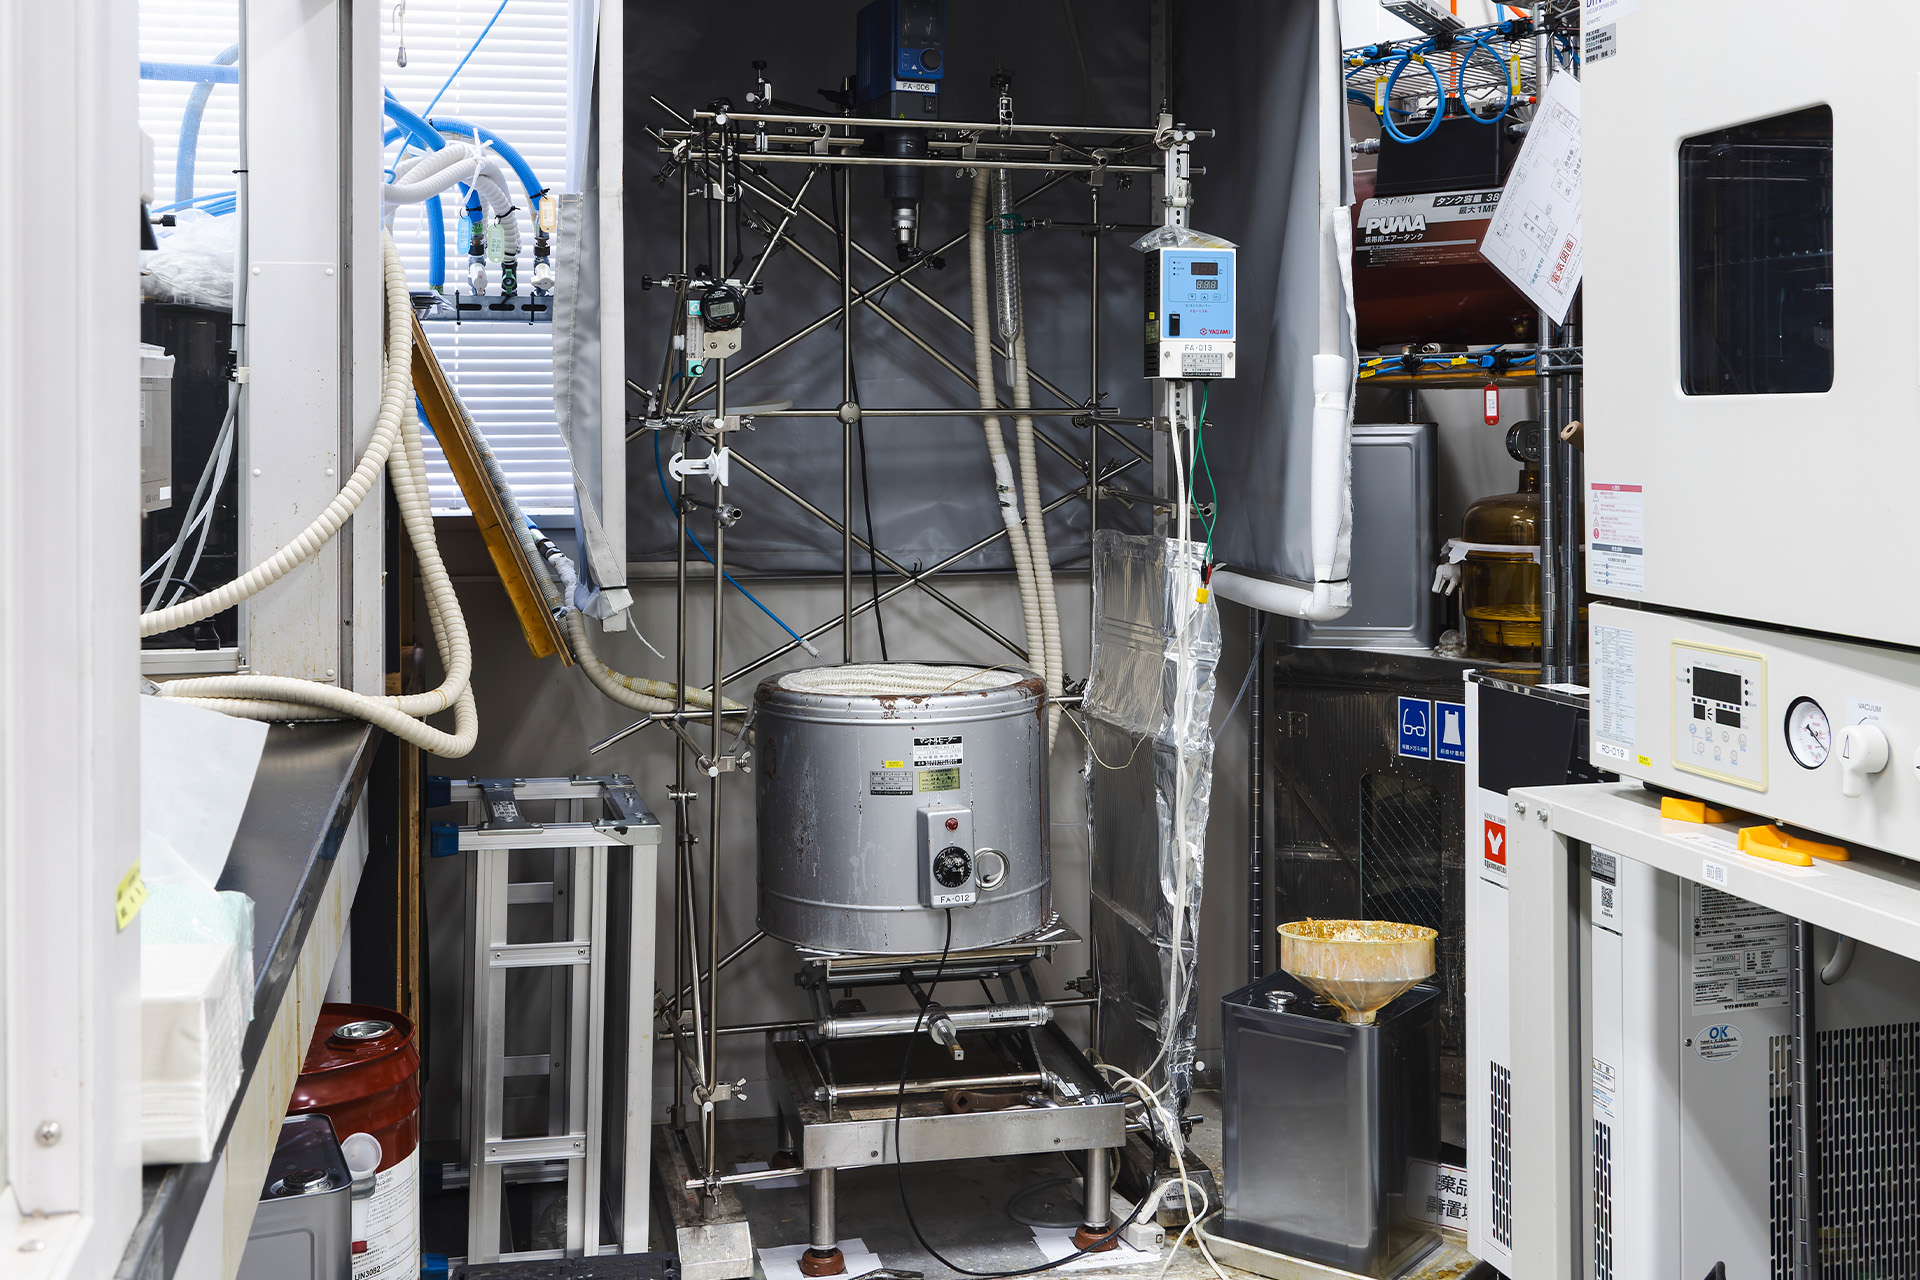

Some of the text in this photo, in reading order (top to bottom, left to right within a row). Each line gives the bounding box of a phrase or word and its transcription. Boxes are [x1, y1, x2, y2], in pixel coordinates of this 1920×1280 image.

[902, 83, 930, 91] FA-006
[1436, 193, 1499, 206] タンク容量 38
[1365, 214, 1427, 235] PUMA
[1364, 233, 1424, 244] 携帯用エアータンク
[1184, 344, 1213, 352] FA-013
[1857, 702, 1882, 713] VACUUM
[1601, 744, 1625, 758] RD-019
[1705, 864, 1724, 883] 前側
[940, 894, 970, 903] FA-012
[1709, 1025, 1729, 1039] OK
[354, 1264, 381, 1280] UN3082
